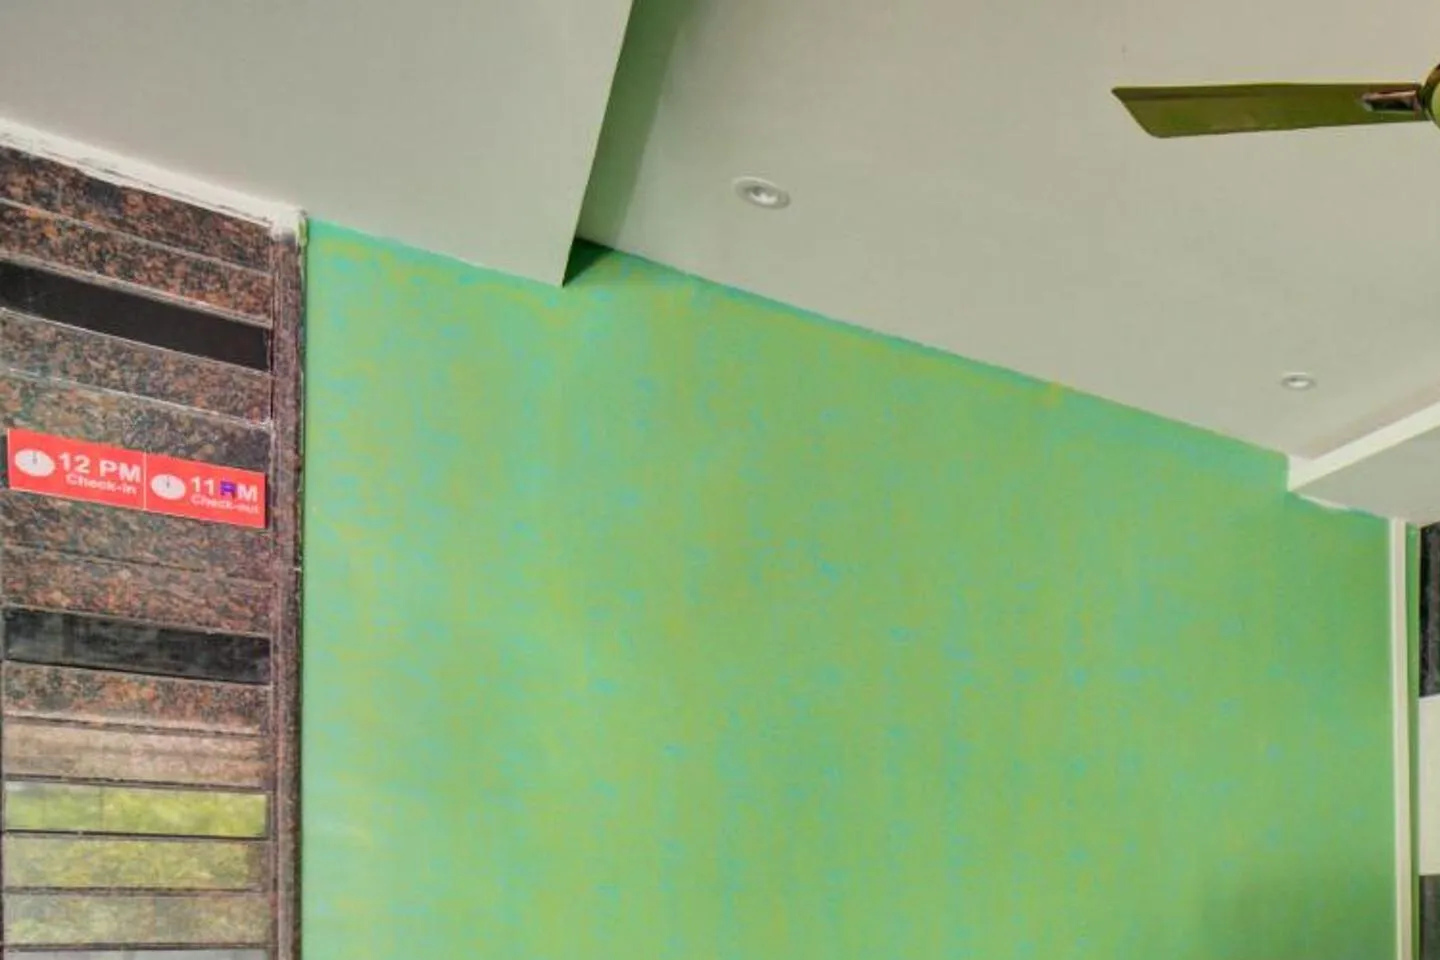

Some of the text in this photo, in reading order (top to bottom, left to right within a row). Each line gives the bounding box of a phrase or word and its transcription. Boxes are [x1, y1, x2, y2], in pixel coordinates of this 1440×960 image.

[59, 452, 141, 483] 12 PM
[65, 472, 138, 495] Check-in
[191, 477, 215, 496] 11
